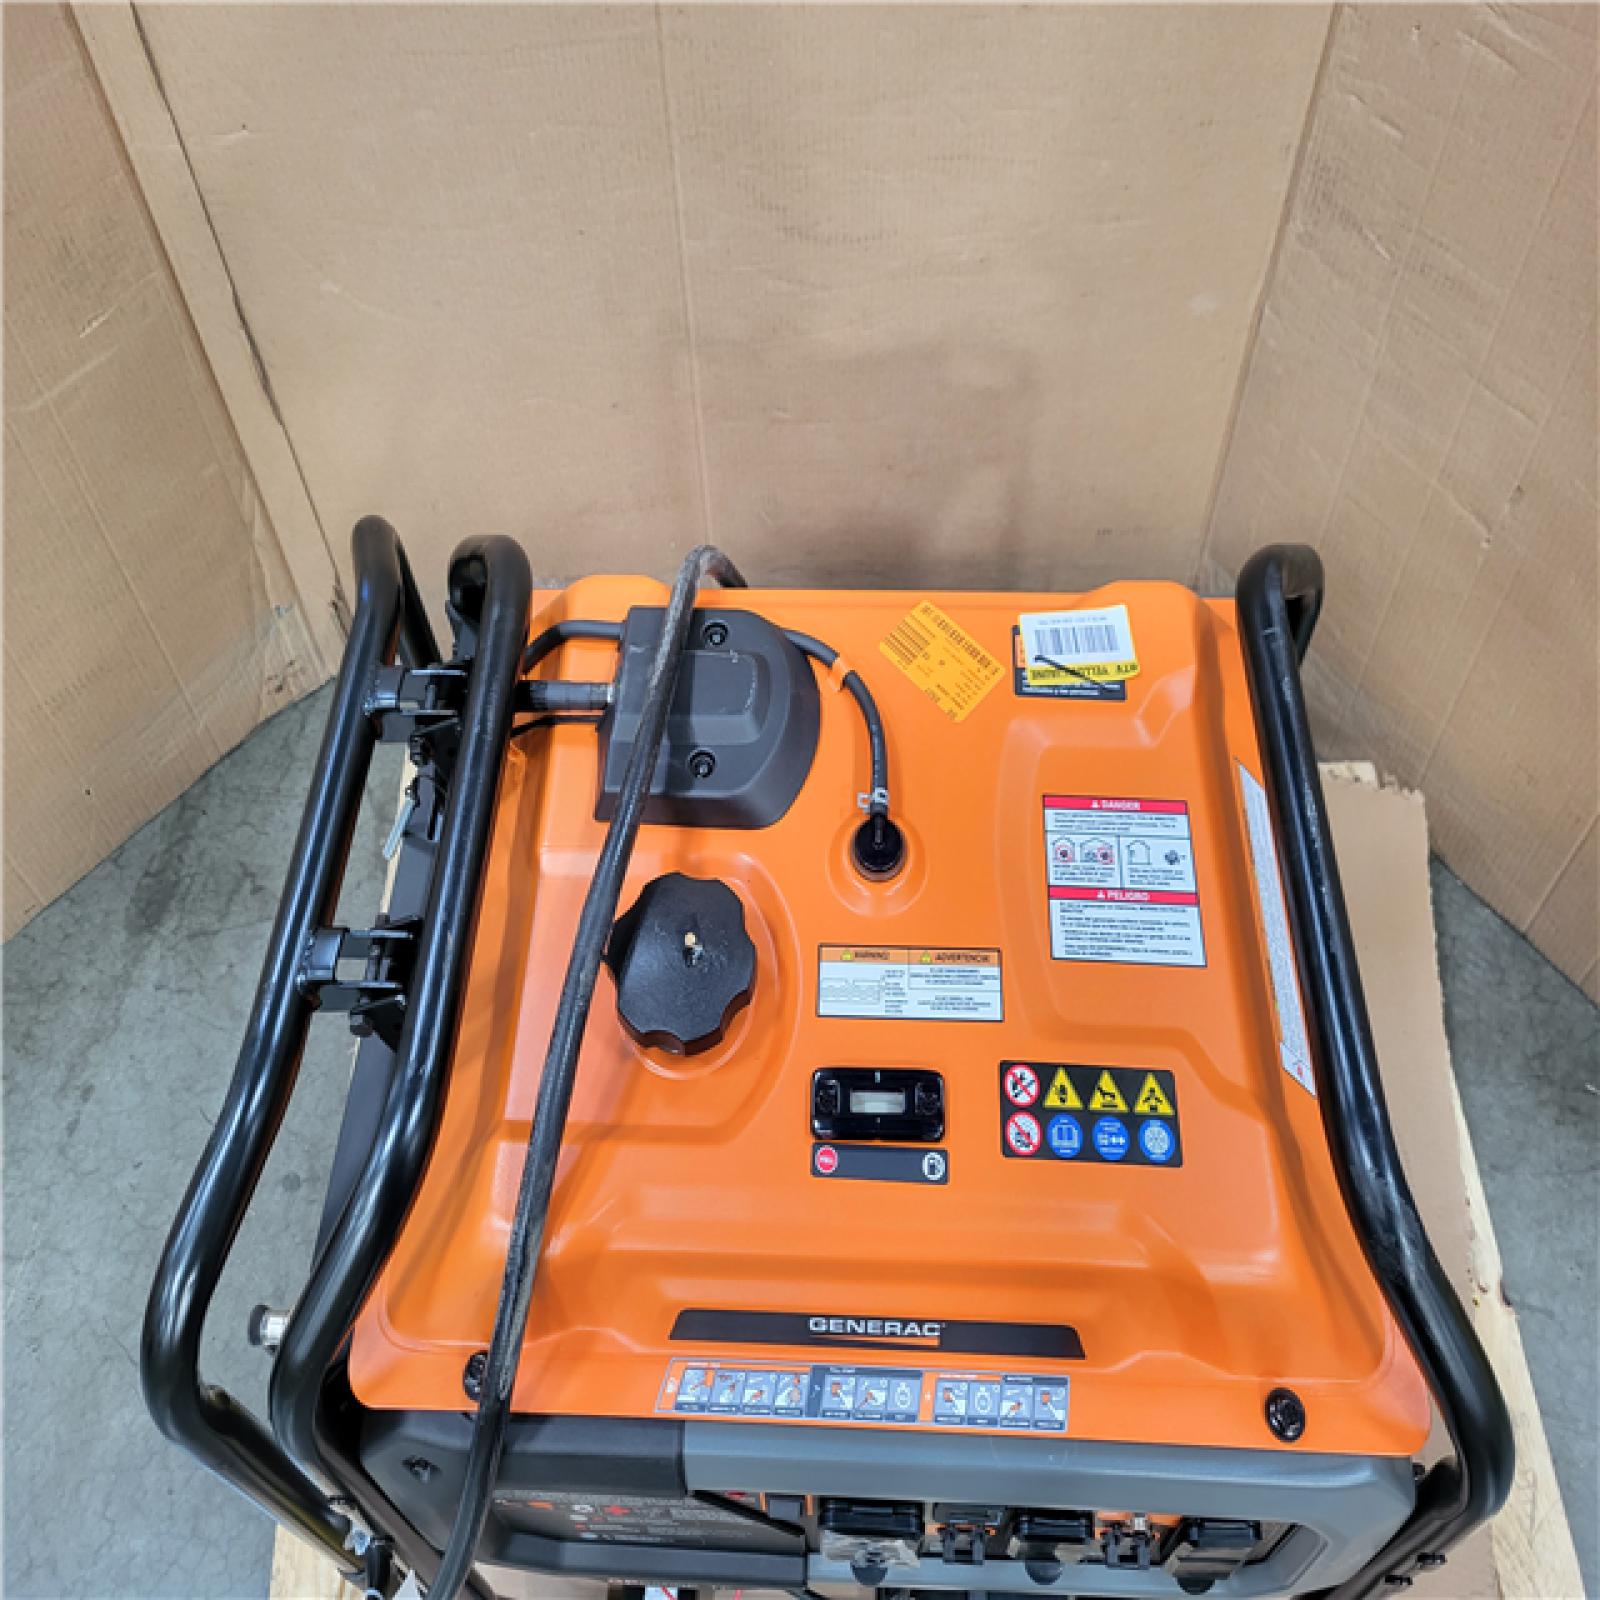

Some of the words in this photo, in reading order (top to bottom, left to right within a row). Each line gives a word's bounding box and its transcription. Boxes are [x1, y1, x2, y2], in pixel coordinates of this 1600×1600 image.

[1101, 799, 1141, 811] DANGER
[1107, 889, 1151, 901] PELIGRO
[854, 951, 890, 961] WARNING
[935, 952, 990, 963] ADVERTENCIA
[809, 1316, 941, 1336] GENERAC
